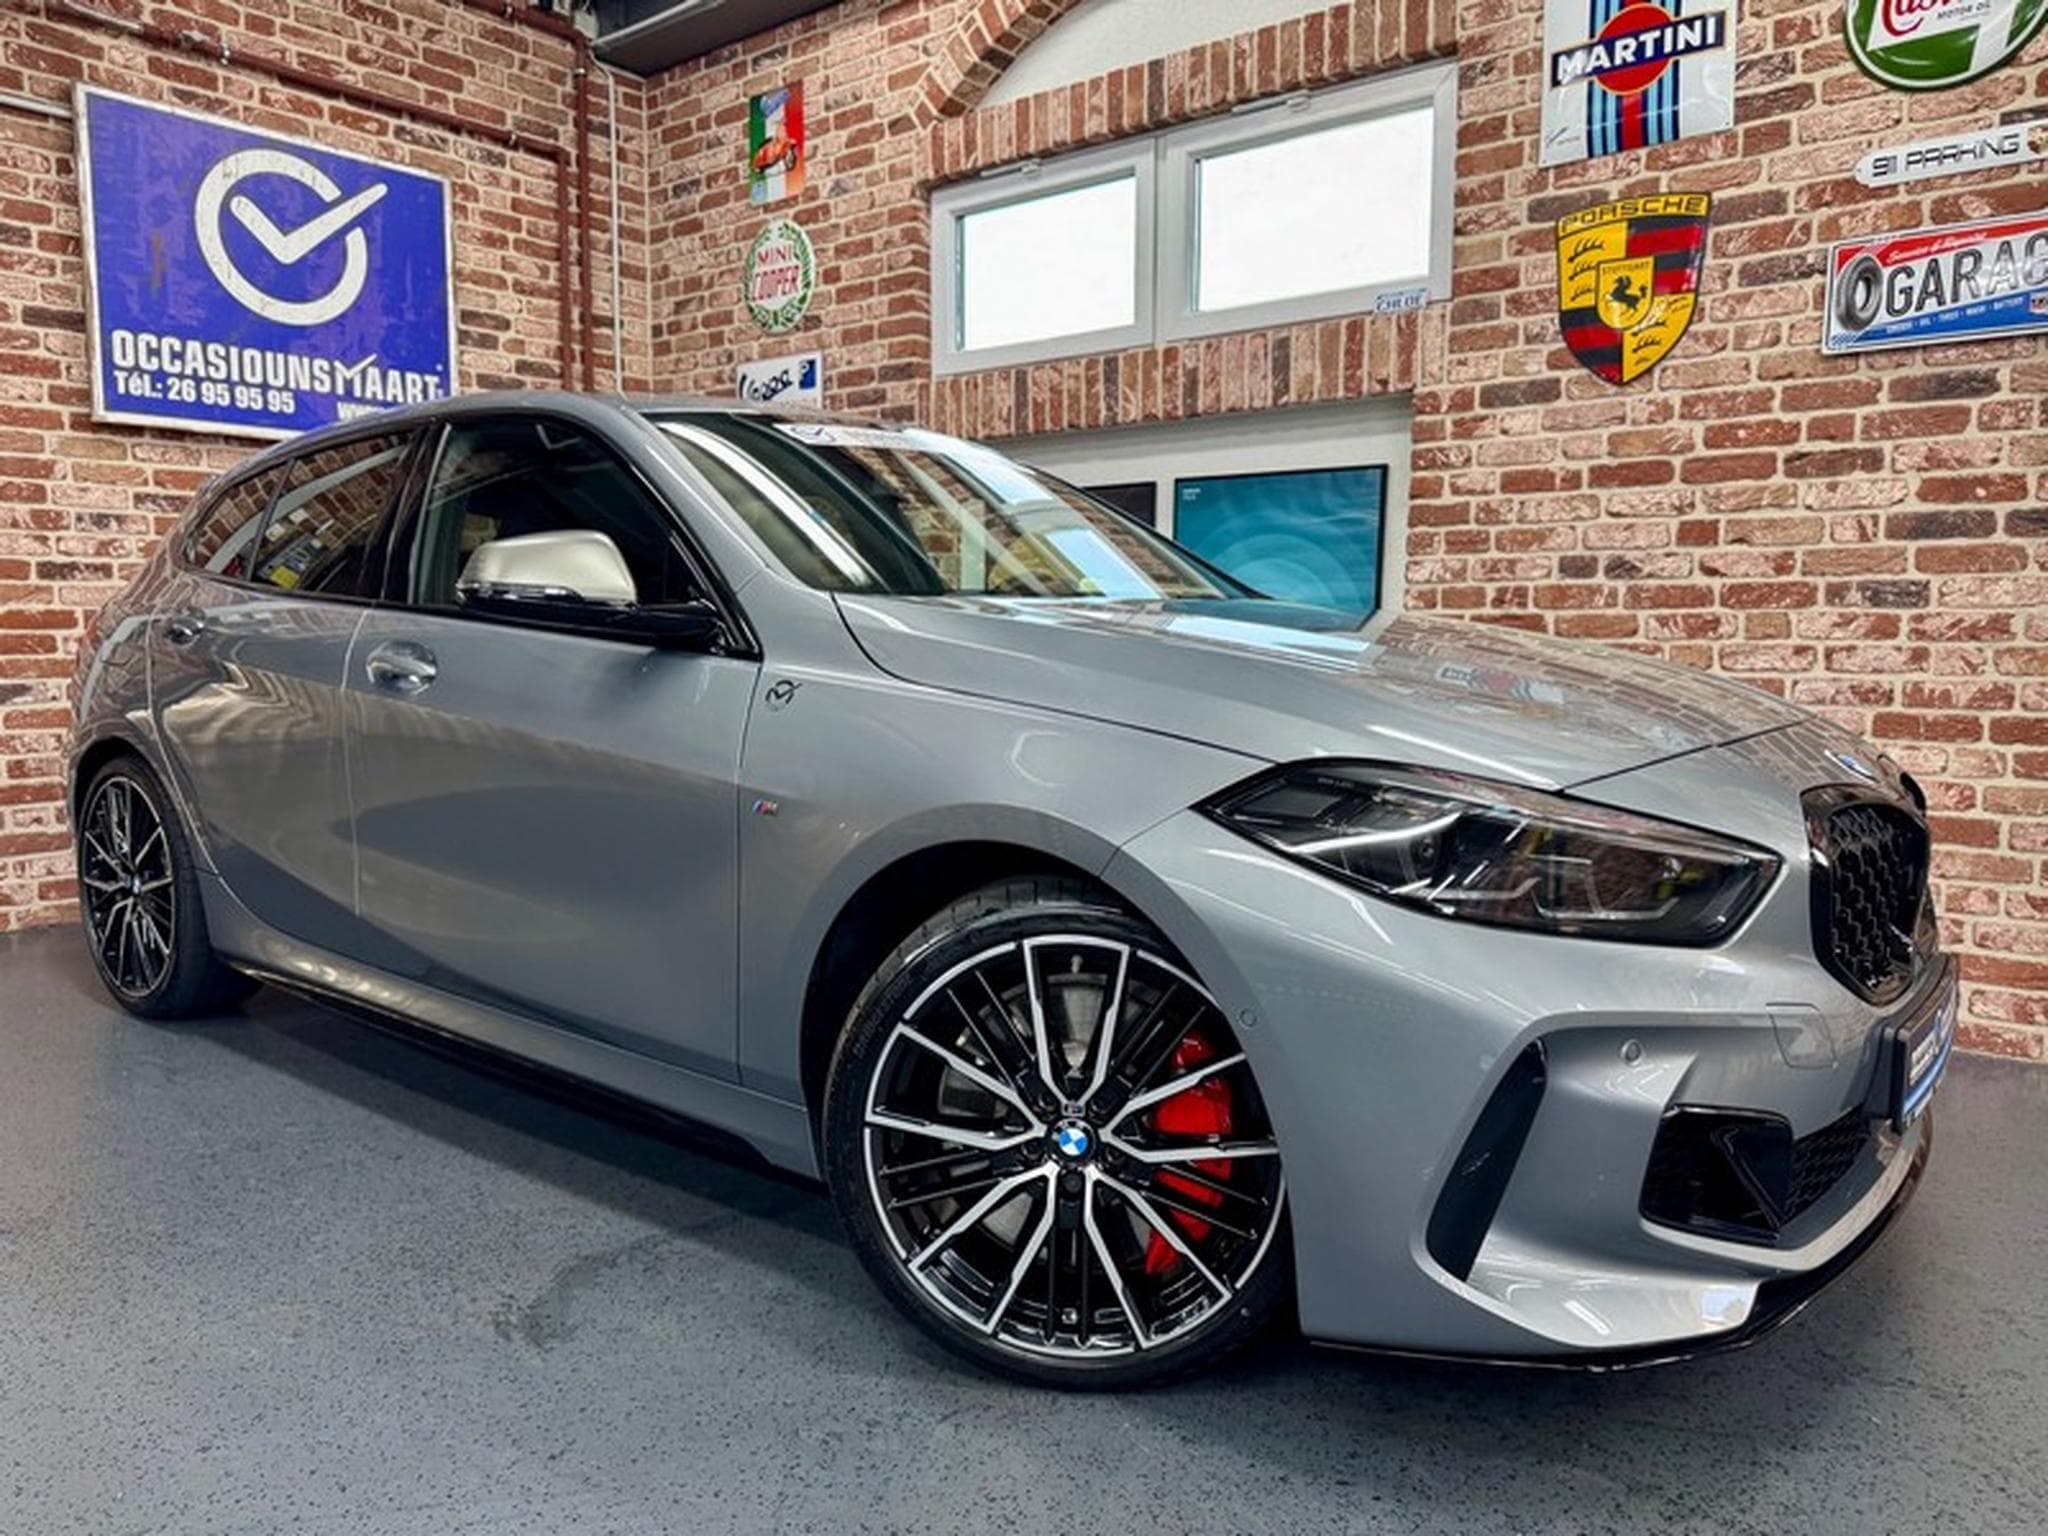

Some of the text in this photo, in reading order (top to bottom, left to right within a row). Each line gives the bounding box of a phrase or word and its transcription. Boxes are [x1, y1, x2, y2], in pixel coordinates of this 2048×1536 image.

[1557, 16, 1716, 82] MARTINI
[1905, 133, 2020, 172] PARKING
[1562, 196, 1704, 233] PORSCHE
[757, 244, 792, 267] MINI
[752, 264, 801, 301] COOPER
[167, 377, 197, 402] 26
[201, 381, 231, 406] 95
[234, 385, 264, 411] 95
[266, 389, 296, 414] 95
